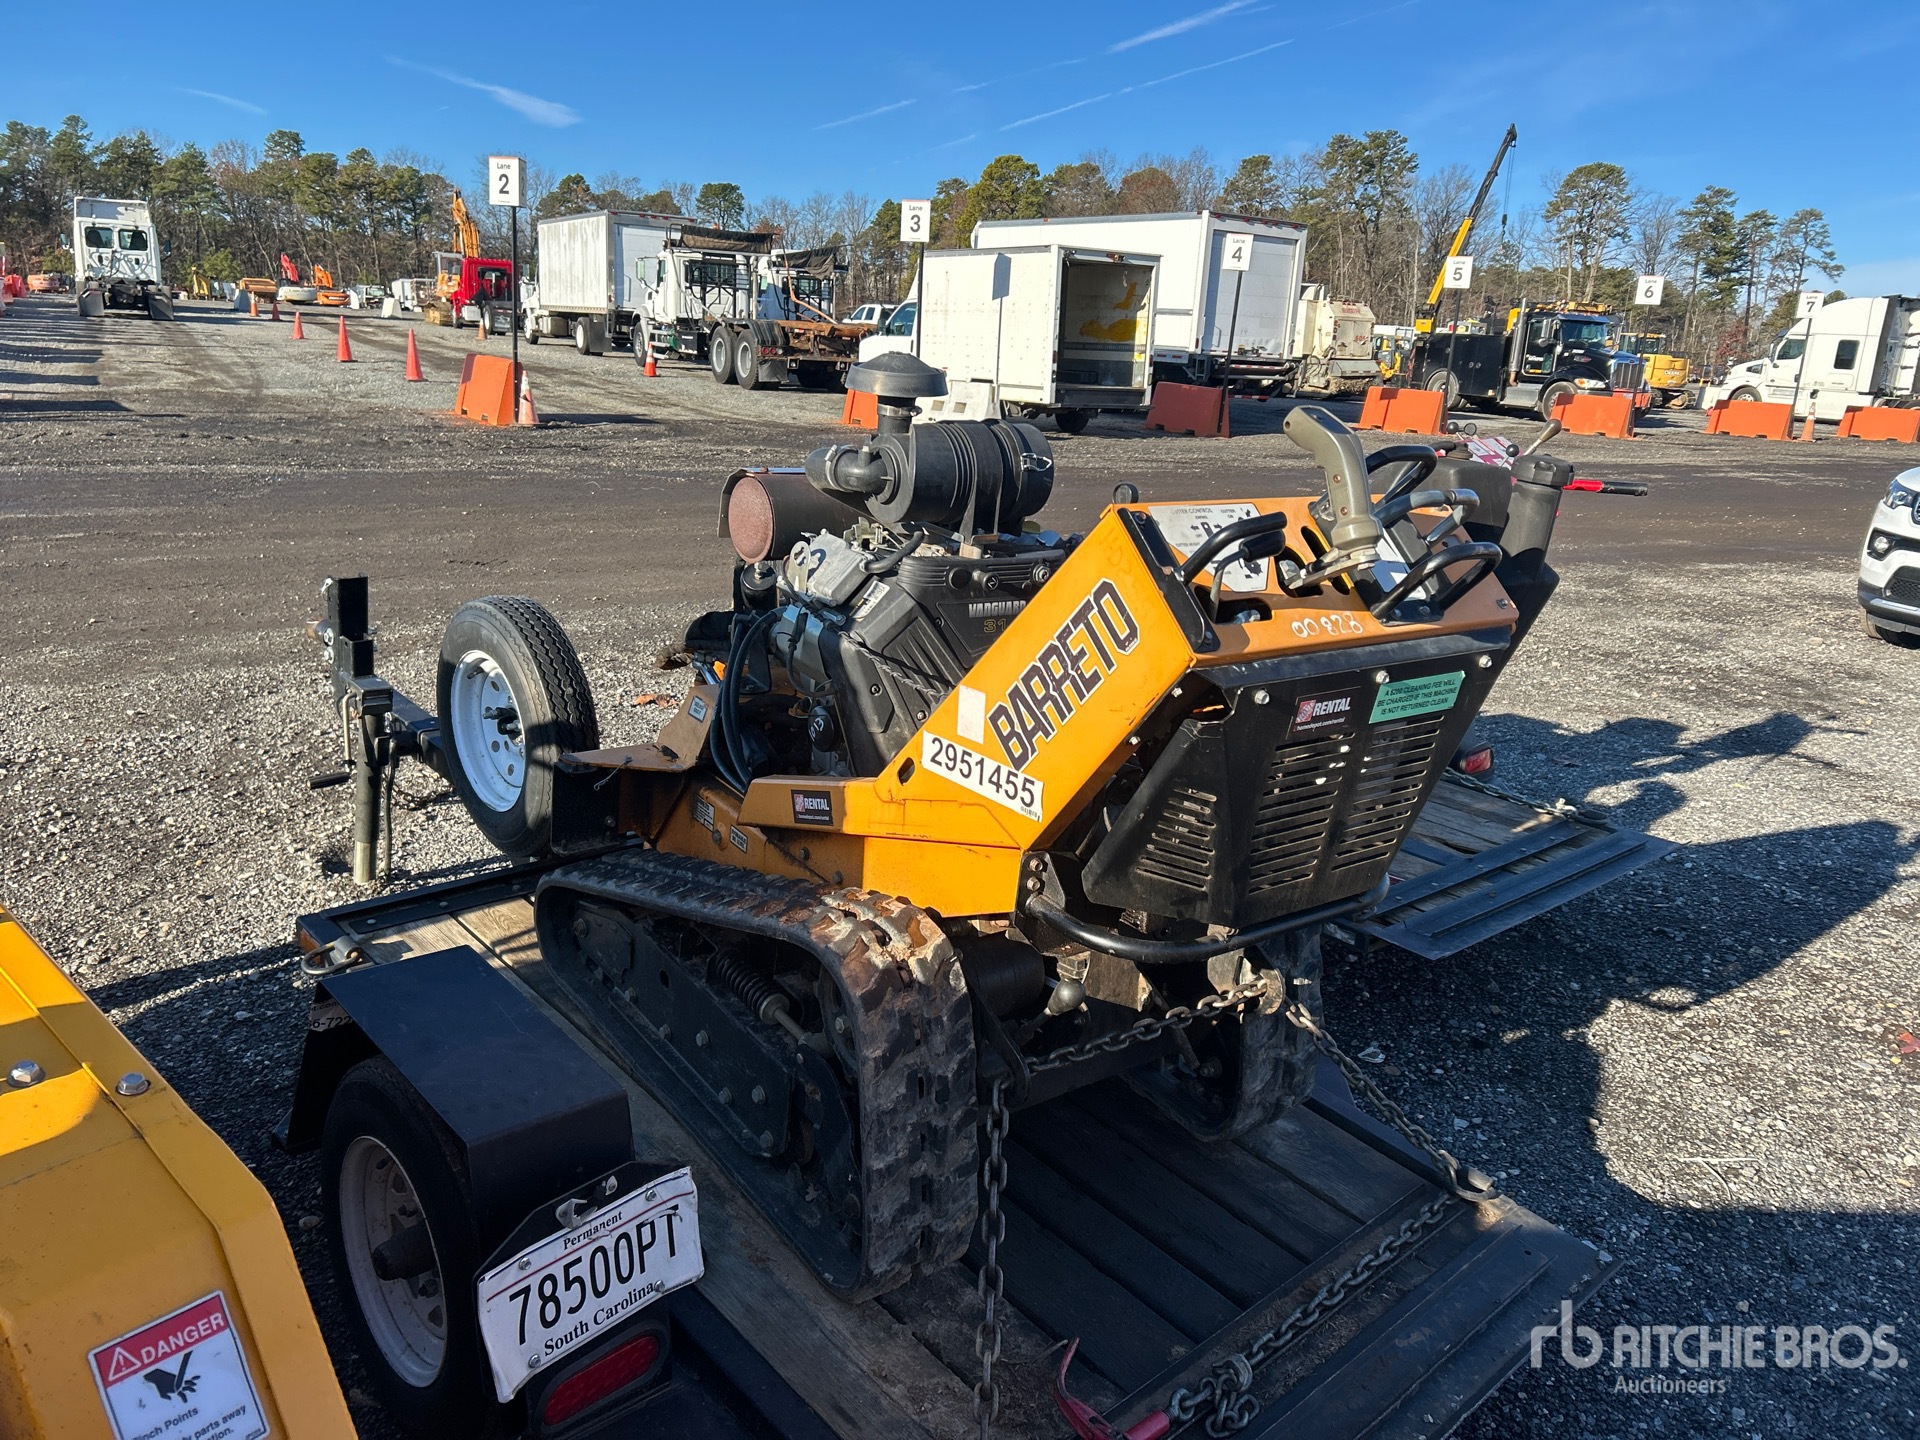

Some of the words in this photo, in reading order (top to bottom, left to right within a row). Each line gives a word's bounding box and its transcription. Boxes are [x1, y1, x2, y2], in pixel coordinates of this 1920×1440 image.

[497, 162, 511, 170] Lane
[499, 173, 509, 194] 2
[910, 214, 921, 232] 3
[1232, 246, 1242, 262] 4
[1453, 267, 1463, 281] 5
[1644, 286, 1654, 298] 6
[1807, 302, 1815, 312] 7
[968, 600, 1026, 618] VANGUARD
[987, 577, 1140, 772] BARRETO
[1403, 683, 1431, 694] CLEANING
[1432, 681, 1442, 689] FEE
[1443, 679, 1456, 687] WILL
[1386, 695, 1414, 706] CHARGED
[1433, 687, 1458, 697] MACHINE
[1388, 706, 1400, 714] NOT
[1400, 701, 1430, 712] RETURNED
[1430, 698, 1448, 707] CLEAN
[1313, 697, 1351, 716] RENTAL
[930, 737, 1035, 808] 2951455
[804, 798, 830, 810] RENTAL
[563, 1211, 623, 1250] Permanent
[509, 1204, 679, 1346] 78500PT
[544, 1322, 590, 1356] South
[593, 1282, 655, 1326] Carolina
[140, 1312, 225, 1364] DANGER
[164, 1408, 198, 1430] Points
[194, 1421, 220, 1440] parts
[222, 1405, 246, 1424] away
